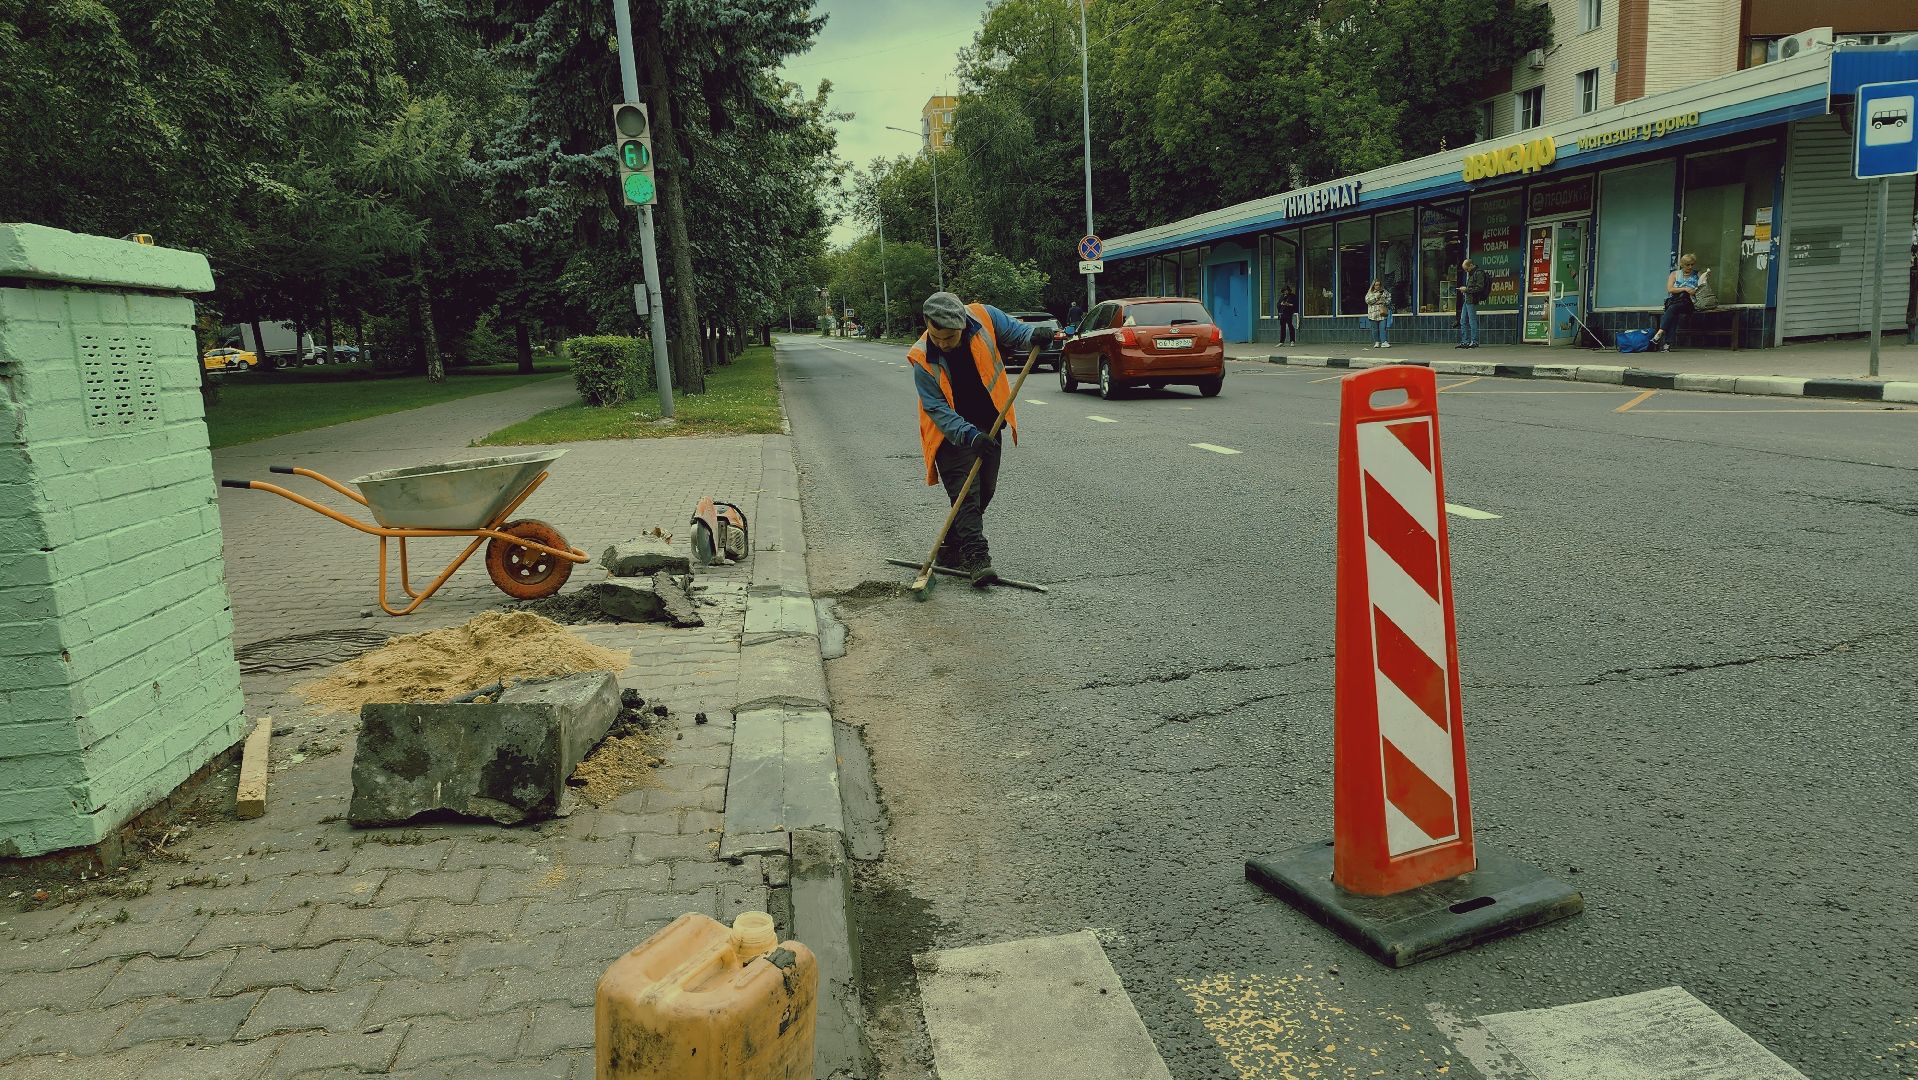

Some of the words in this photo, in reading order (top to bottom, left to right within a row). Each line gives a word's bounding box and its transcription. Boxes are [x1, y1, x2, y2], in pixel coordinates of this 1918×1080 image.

[1482, 226, 1510, 239] ДЕТСКИЕ
[1483, 240, 1509, 252] ТОВАРЫ
[1482, 254, 1509, 265] ПОСУДА
[1491, 280, 1514, 291] ОВАРЫ
[1488, 292, 1519, 305] МЕЛОЧЕЙ
